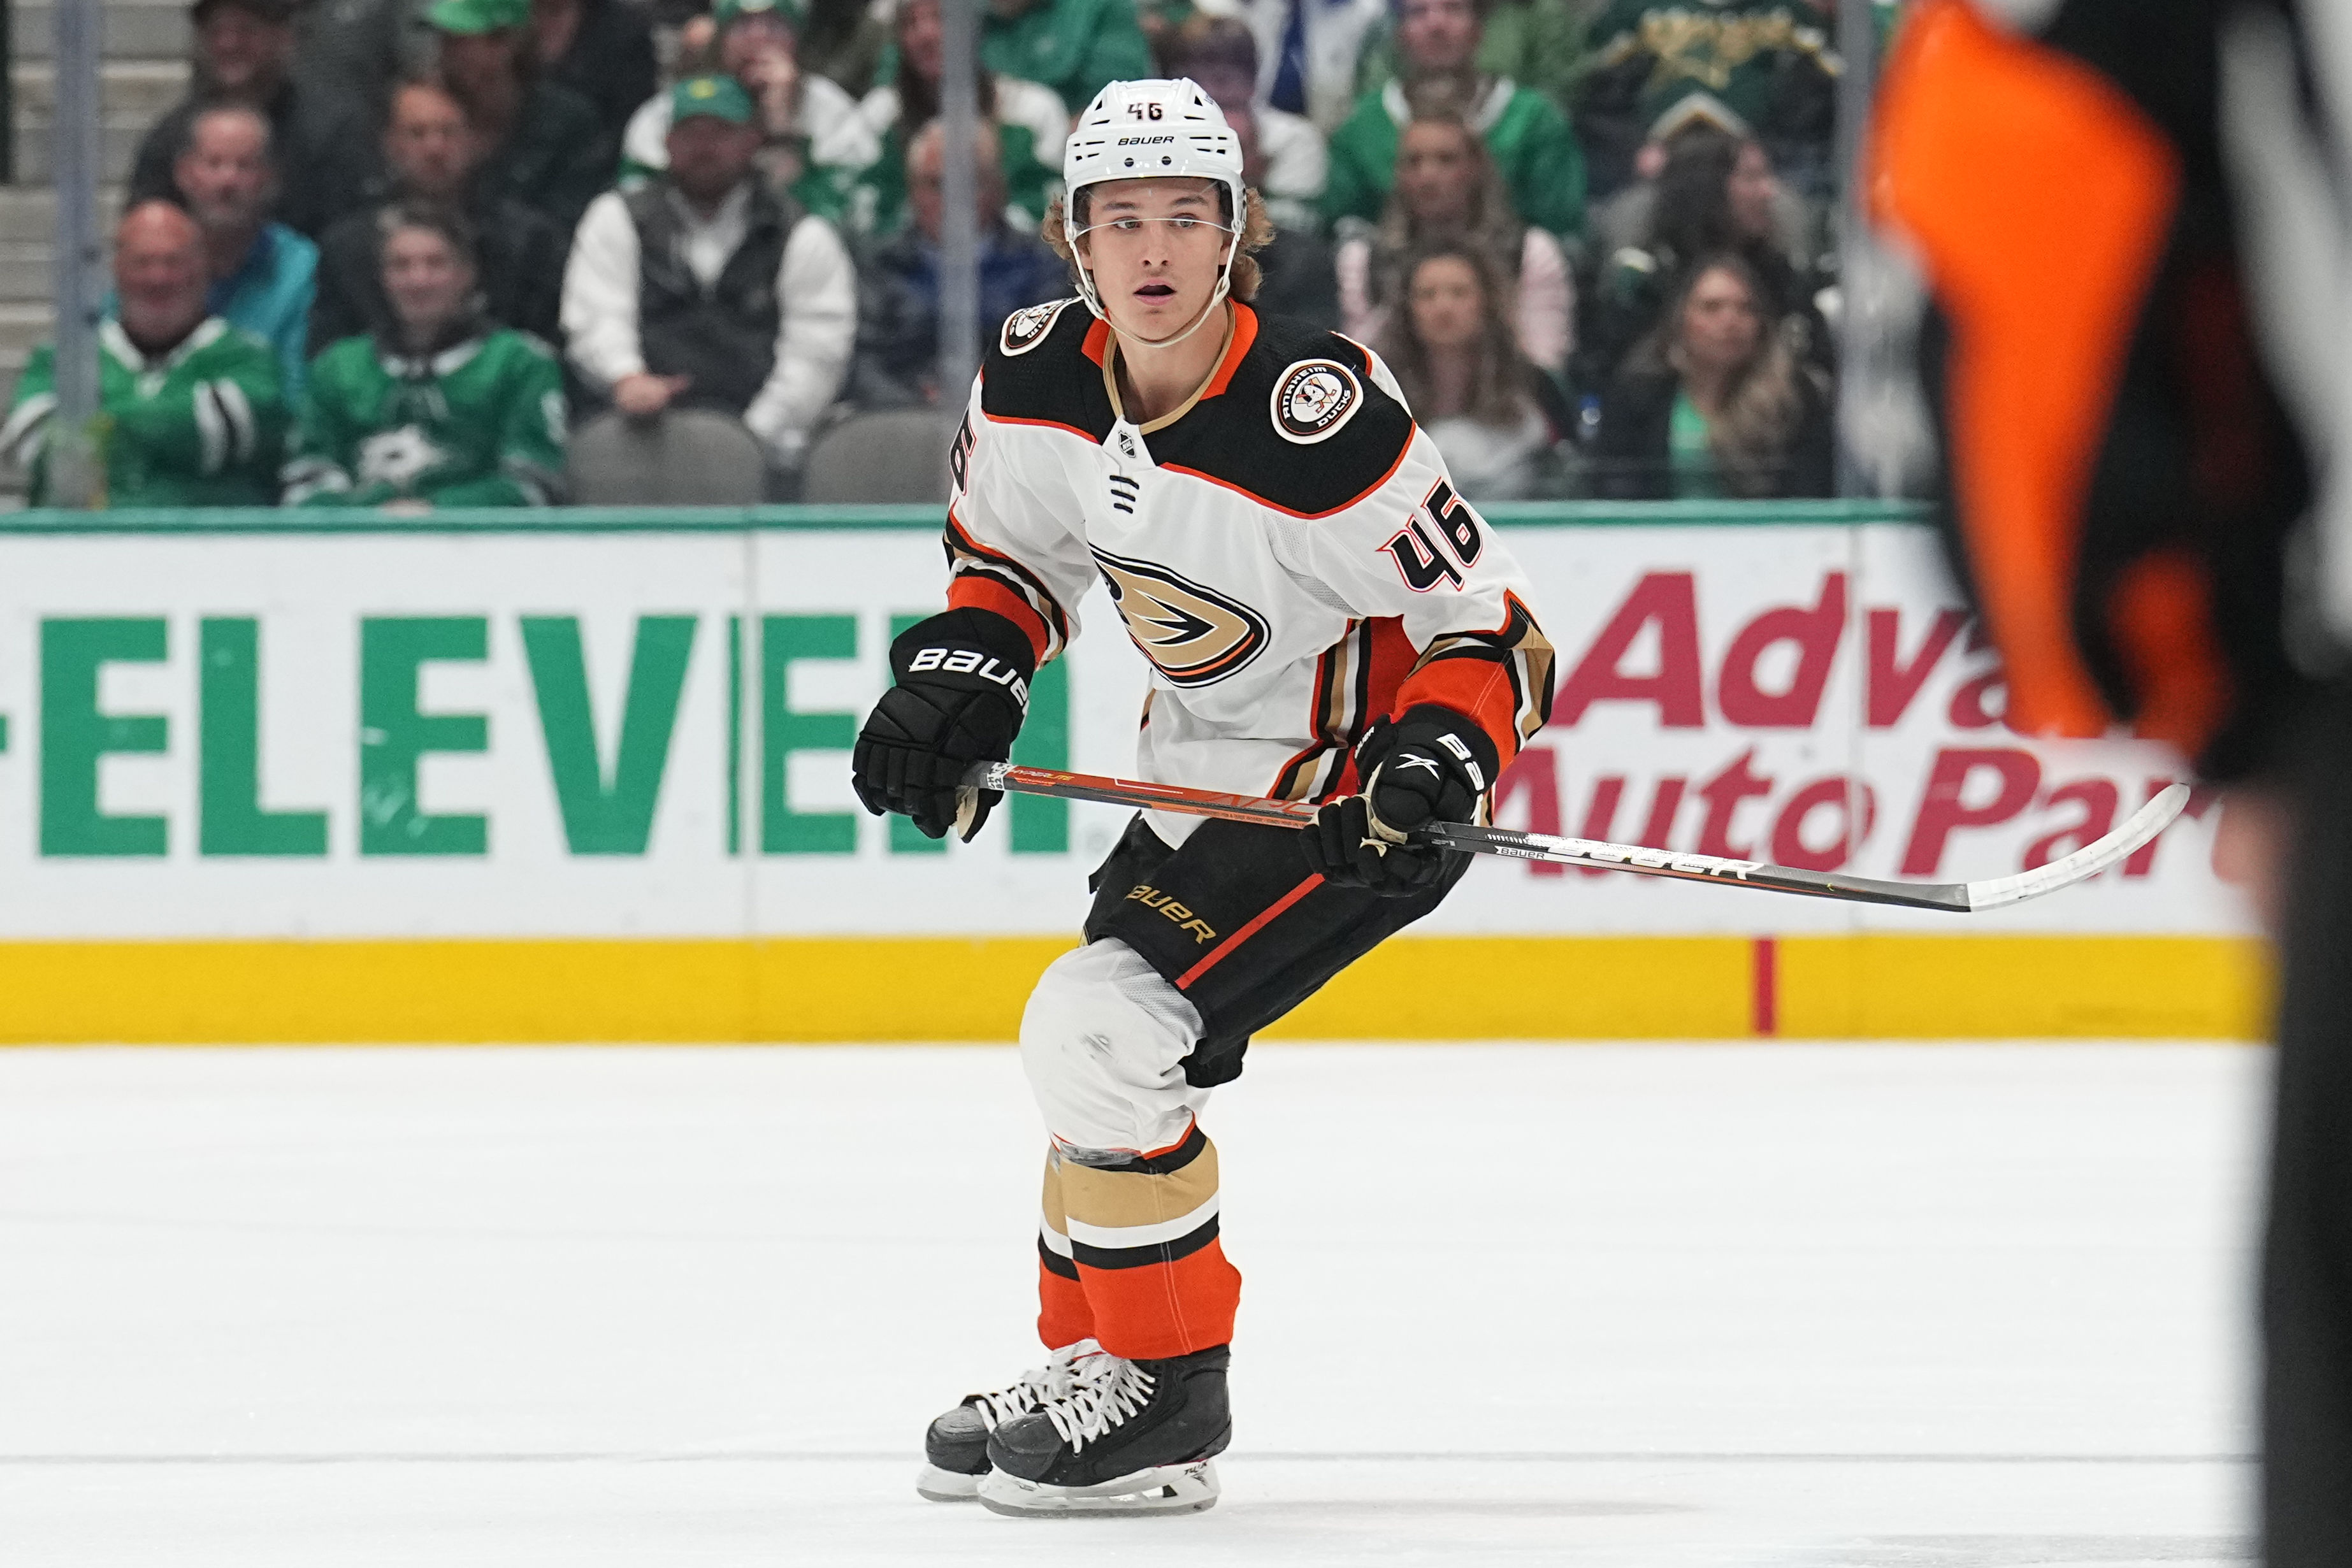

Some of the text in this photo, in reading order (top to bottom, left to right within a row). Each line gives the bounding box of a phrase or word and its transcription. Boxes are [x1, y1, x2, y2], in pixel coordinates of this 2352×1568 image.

[1127, 102, 1164, 121] 46
[1117, 135, 1175, 147] BAUER
[1282, 366, 1327, 420] ANAHEIM
[1316, 389, 1351, 428] DUCKS
[1375, 477, 1483, 593] 46
[0, 615, 1069, 856] ELEVE
[1492, 745, 1876, 877] Auto
[1501, 847, 1545, 860] BAUER
